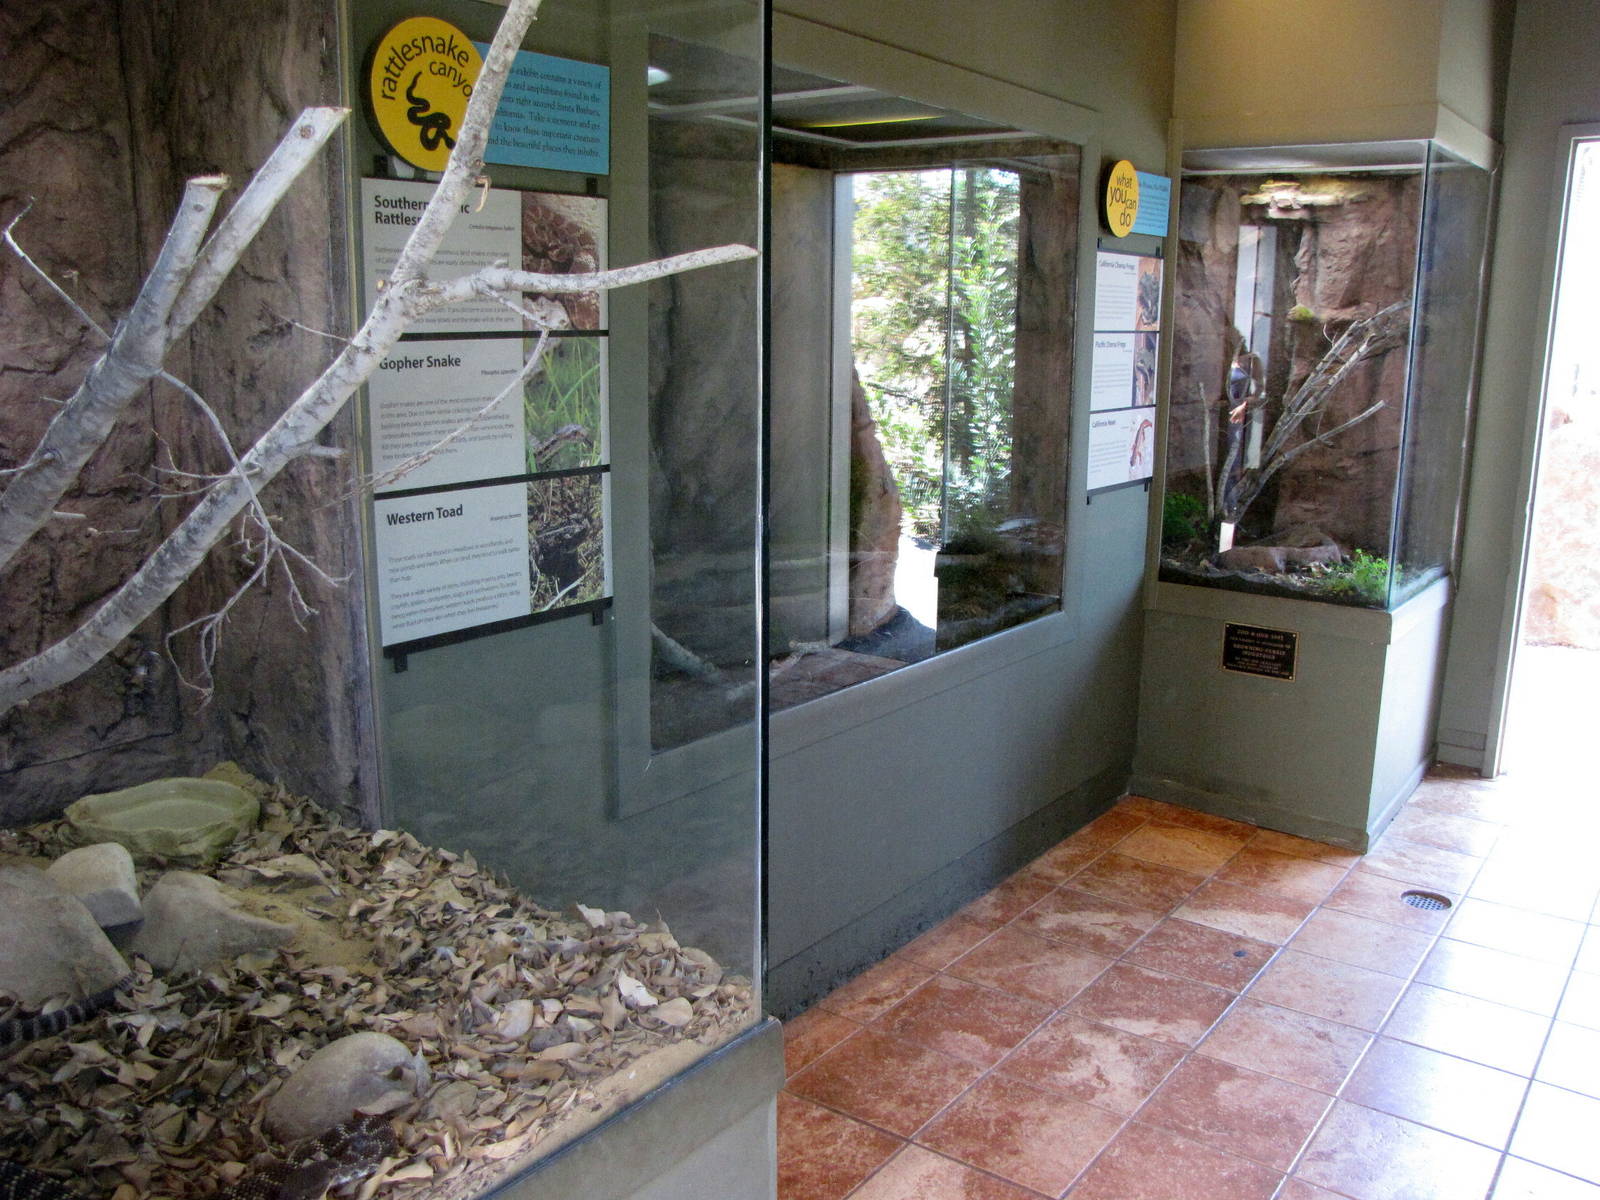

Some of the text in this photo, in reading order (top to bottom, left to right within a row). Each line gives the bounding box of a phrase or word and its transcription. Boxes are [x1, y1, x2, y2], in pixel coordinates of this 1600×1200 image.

[382, 34, 469, 101] rattlesnake
[429, 61, 473, 101] canyo
[1117, 173, 1133, 189] what
[1109, 187, 1128, 207] you
[1126, 199, 1137, 210] can
[1120, 208, 1132, 227] do
[379, 354, 461, 372] Gopher Snake
[387, 504, 463, 526] Western Toad
